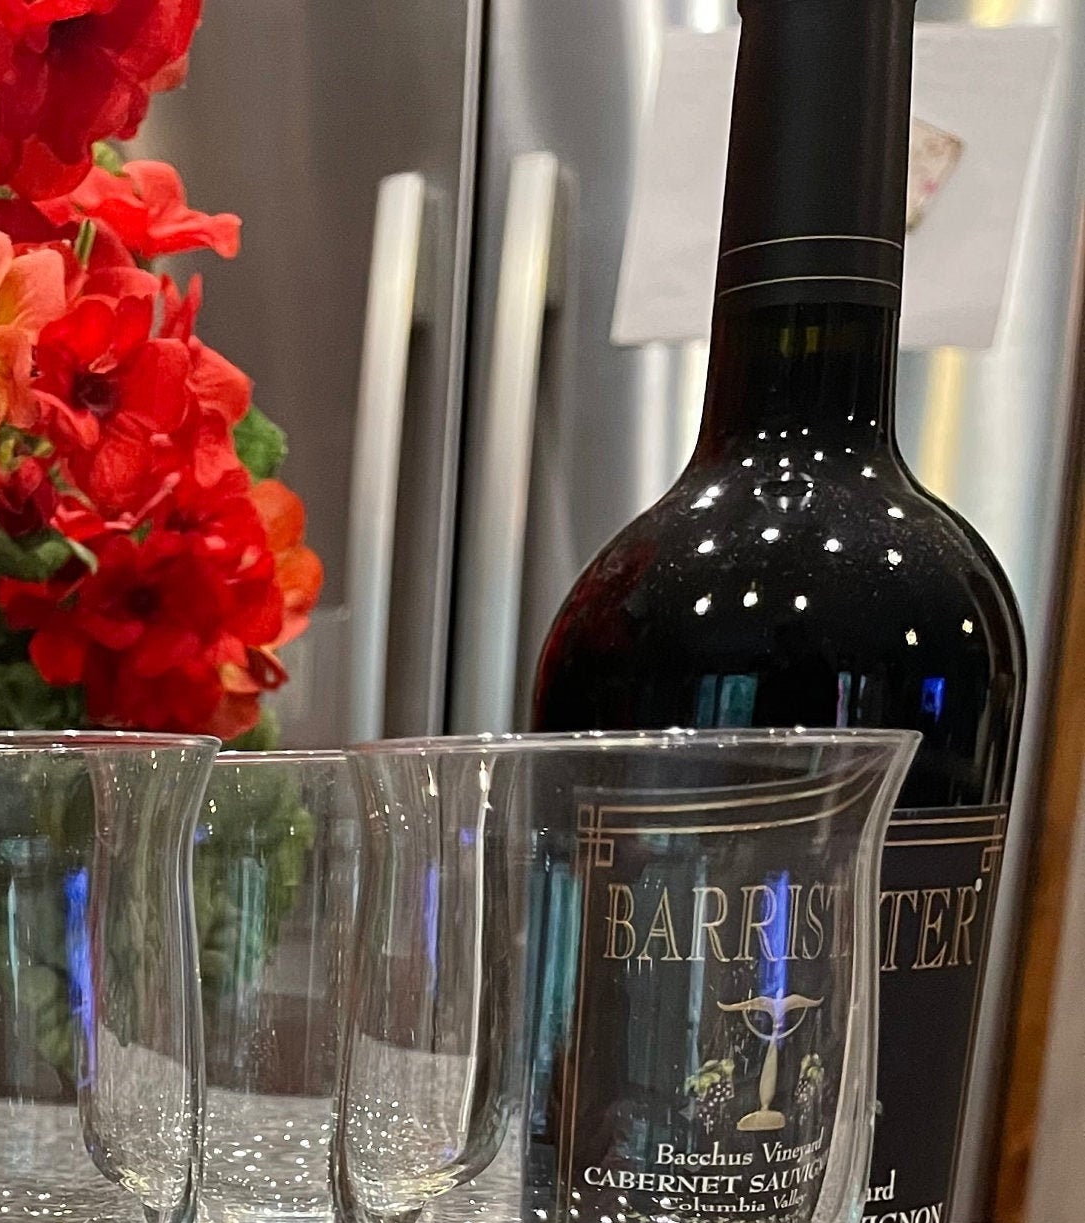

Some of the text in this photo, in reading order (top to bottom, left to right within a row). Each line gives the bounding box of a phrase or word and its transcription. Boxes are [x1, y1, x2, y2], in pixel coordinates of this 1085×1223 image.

[657, 1126, 825, 1166] Bacchus Vineyard
[584, 1166, 742, 1194] CABERNET
[659, 1188, 807, 1212] Columbia Valley
